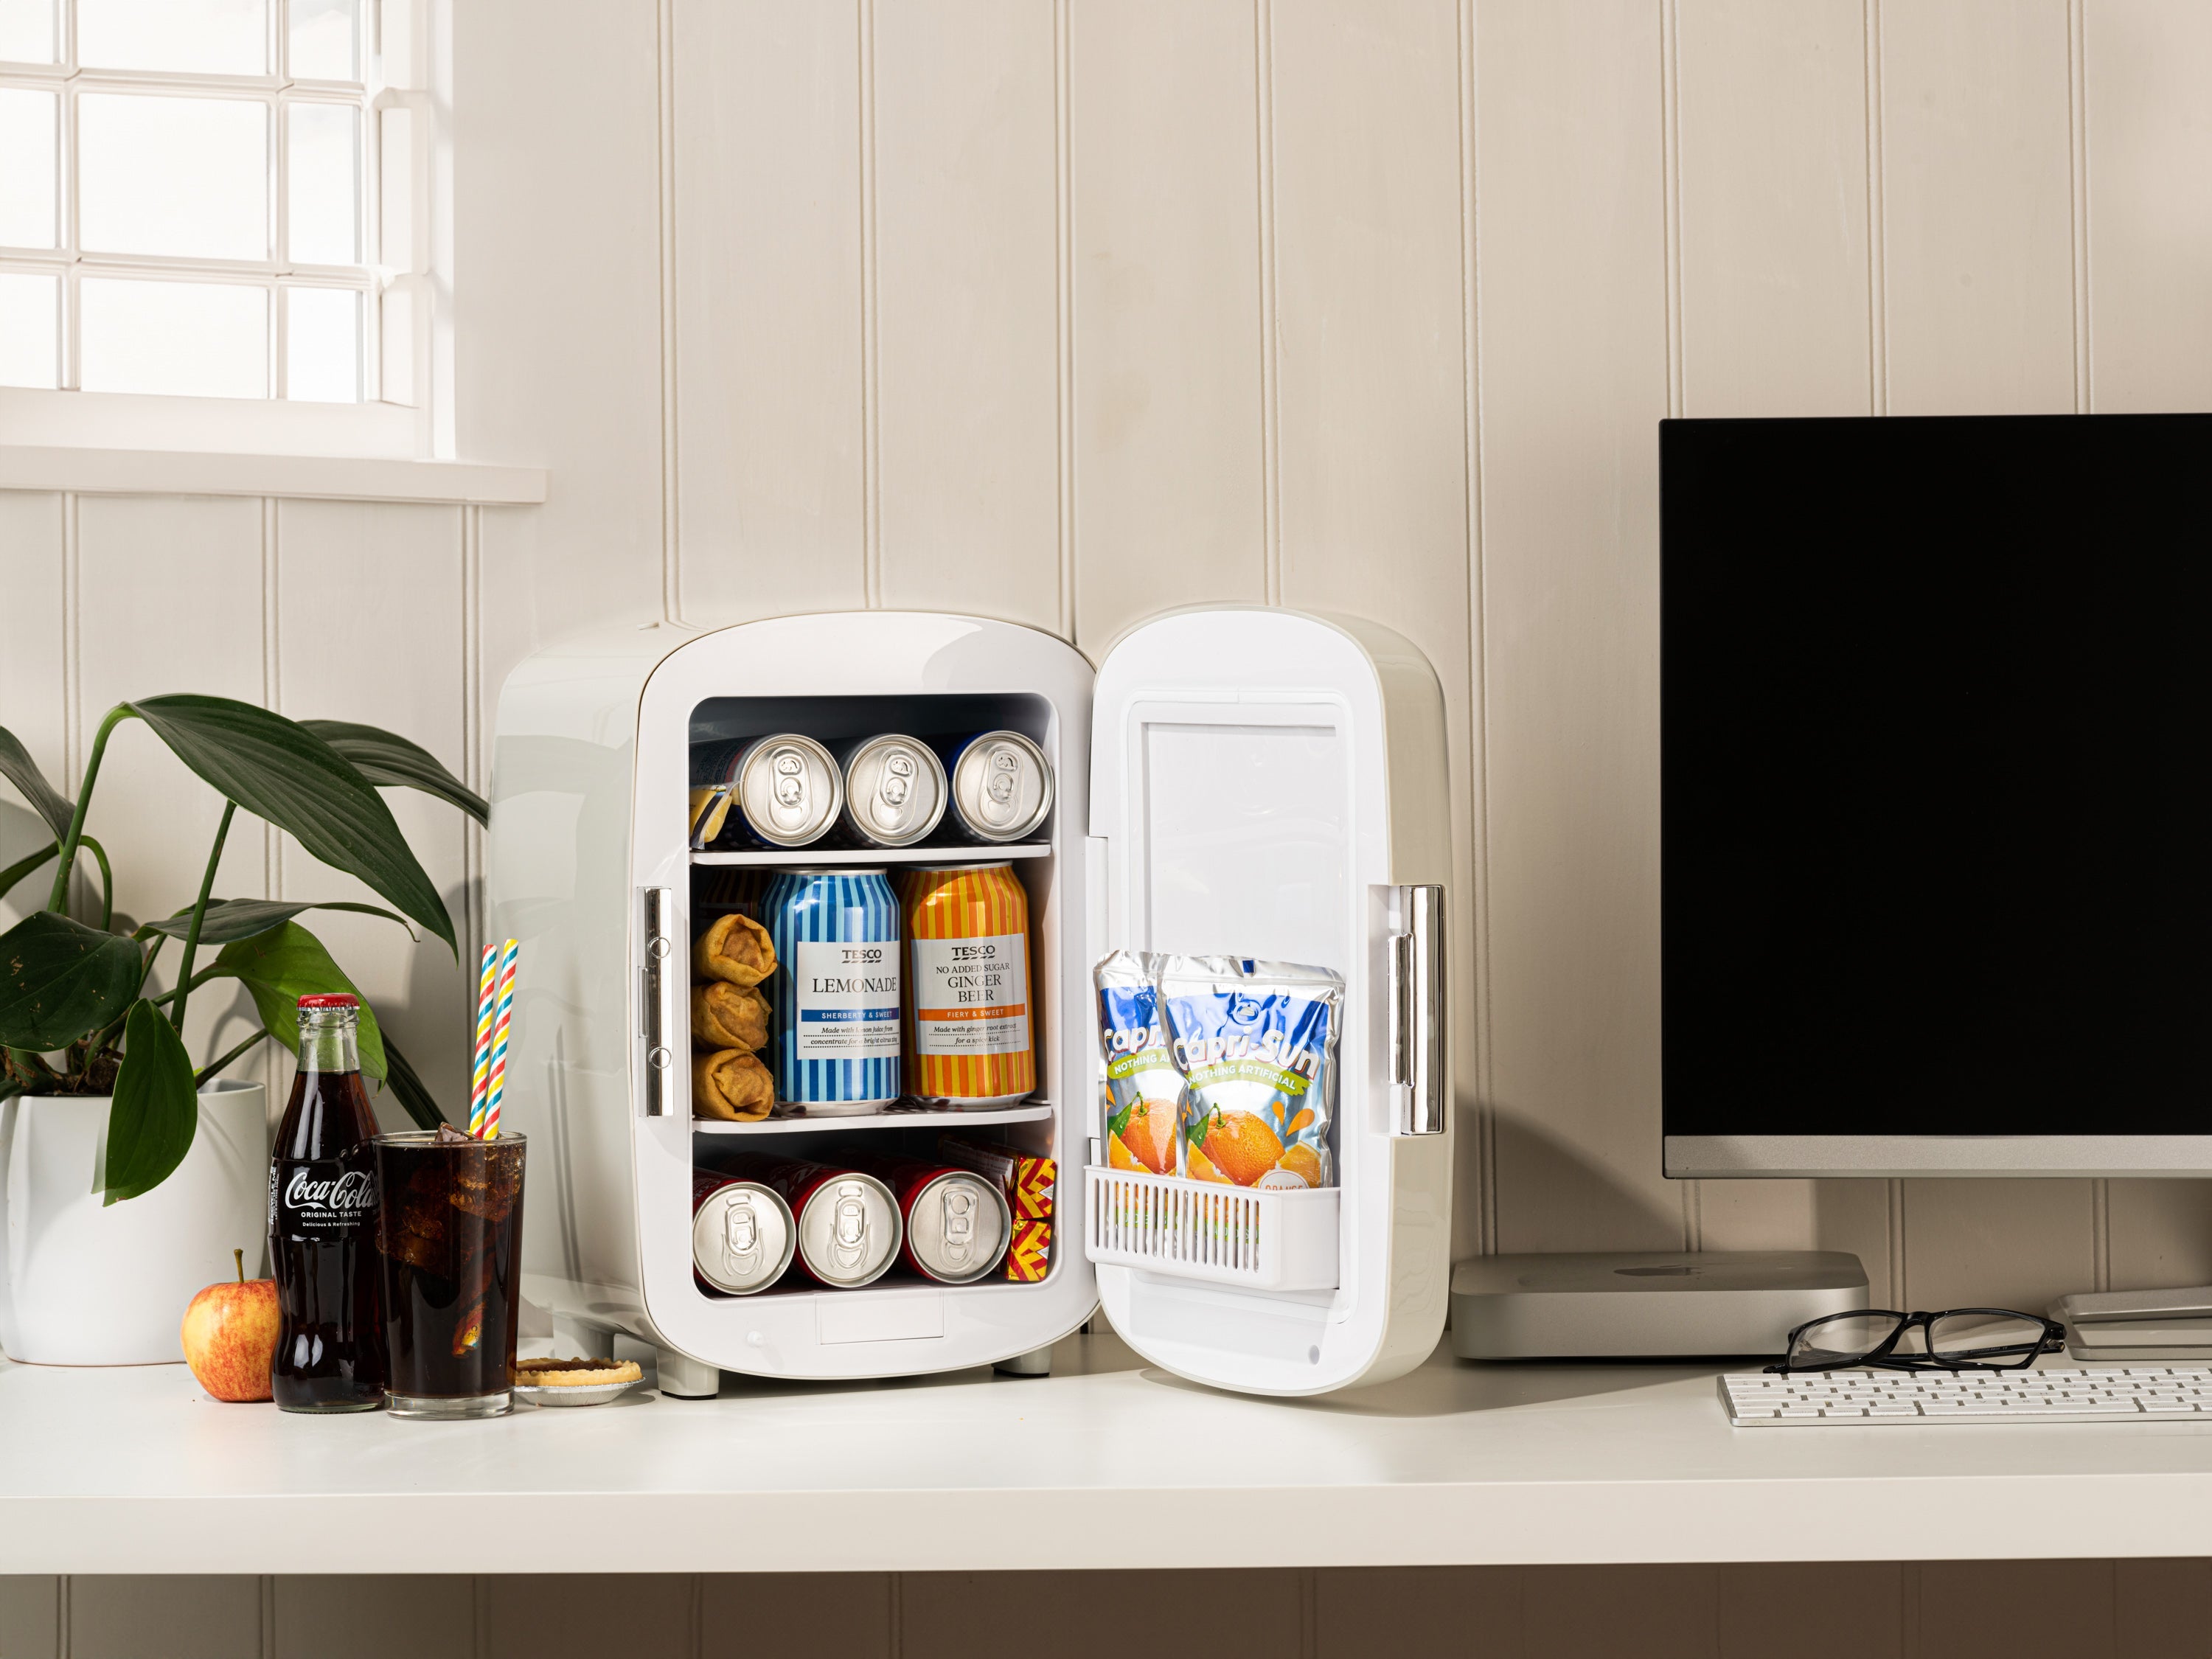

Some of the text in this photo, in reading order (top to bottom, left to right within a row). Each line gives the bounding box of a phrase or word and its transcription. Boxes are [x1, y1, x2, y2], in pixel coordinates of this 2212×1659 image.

[842, 949, 882, 959] TESCO
[952, 945, 995, 956] TESCO
[936, 962, 1010, 974] NO ADDED SUGAR
[813, 977, 897, 992] LEMONADE
[948, 974, 1001, 988] GINGER
[959, 990, 994, 1003] BEER
[981, 1009, 1004, 1017] SWEET
[872, 1026, 883, 1034] juice
[883, 1025, 893, 1034] from
[967, 1026, 985, 1034] ginger
[848, 1037, 858, 1046] for
[955, 1037, 966, 1045] for
[1173, 1026, 1321, 1081] Capri-Sun
[1114, 1054, 1158, 1075] NOTHING
[1189, 1064, 1296, 1091] NOTHING ARTIFICIAL
[285, 1171, 374, 1210] Coca-Cola
